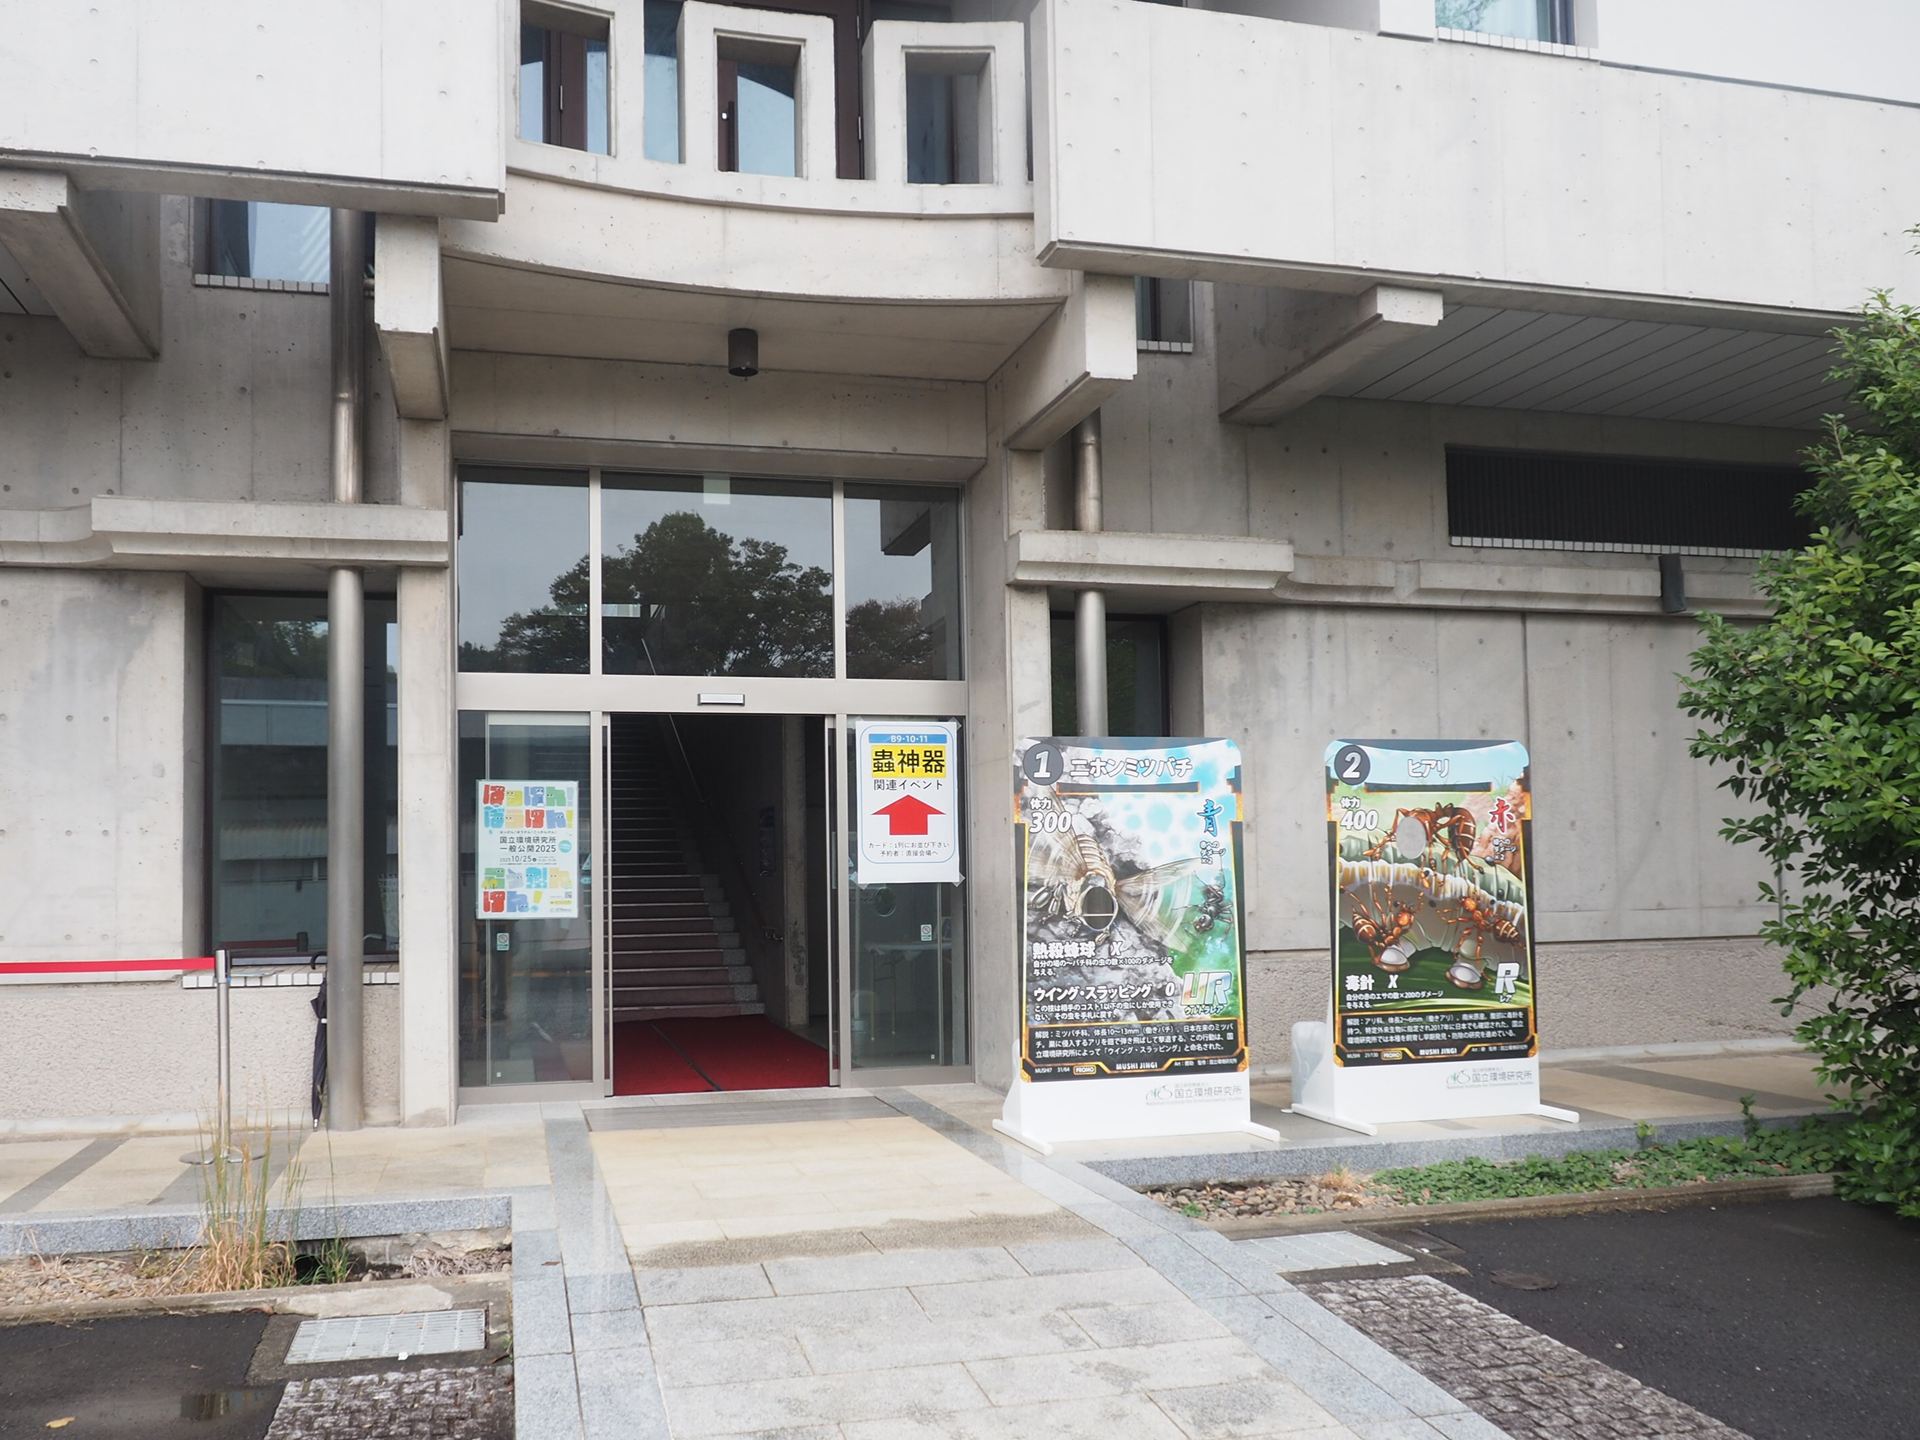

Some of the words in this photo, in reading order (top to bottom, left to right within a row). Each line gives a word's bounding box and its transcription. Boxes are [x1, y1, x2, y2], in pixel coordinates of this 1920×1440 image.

[872, 749, 945, 773] 蟲神器
[1033, 750, 1051, 778] 1
[1069, 757, 1193, 778] ニホンミツバチ
[1342, 752, 1361, 779] 2
[1408, 759, 1450, 778] ヒアリ
[873, 779, 943, 791] 関連イベント
[1030, 797, 1052, 810] 体力
[1340, 796, 1361, 809] 体力
[1029, 811, 1072, 834] 300
[1197, 798, 1222, 837] 青
[1340, 810, 1378, 831] 400
[1489, 798, 1515, 833] 赤
[500, 836, 556, 844] 国立環境研究所
[1032, 941, 1096, 959] 熱殺蜂球
[1345, 974, 1375, 991] 毒針
[1495, 963, 1519, 994] R
[1165, 982, 1175, 997] 0
[1181, 972, 1232, 1006] UR
[1184, 1005, 1224, 1015] ウルトラレア
[1472, 1070, 1533, 1083] 国立環境研究所
[1174, 1086, 1242, 1099] 国立環境研究所
